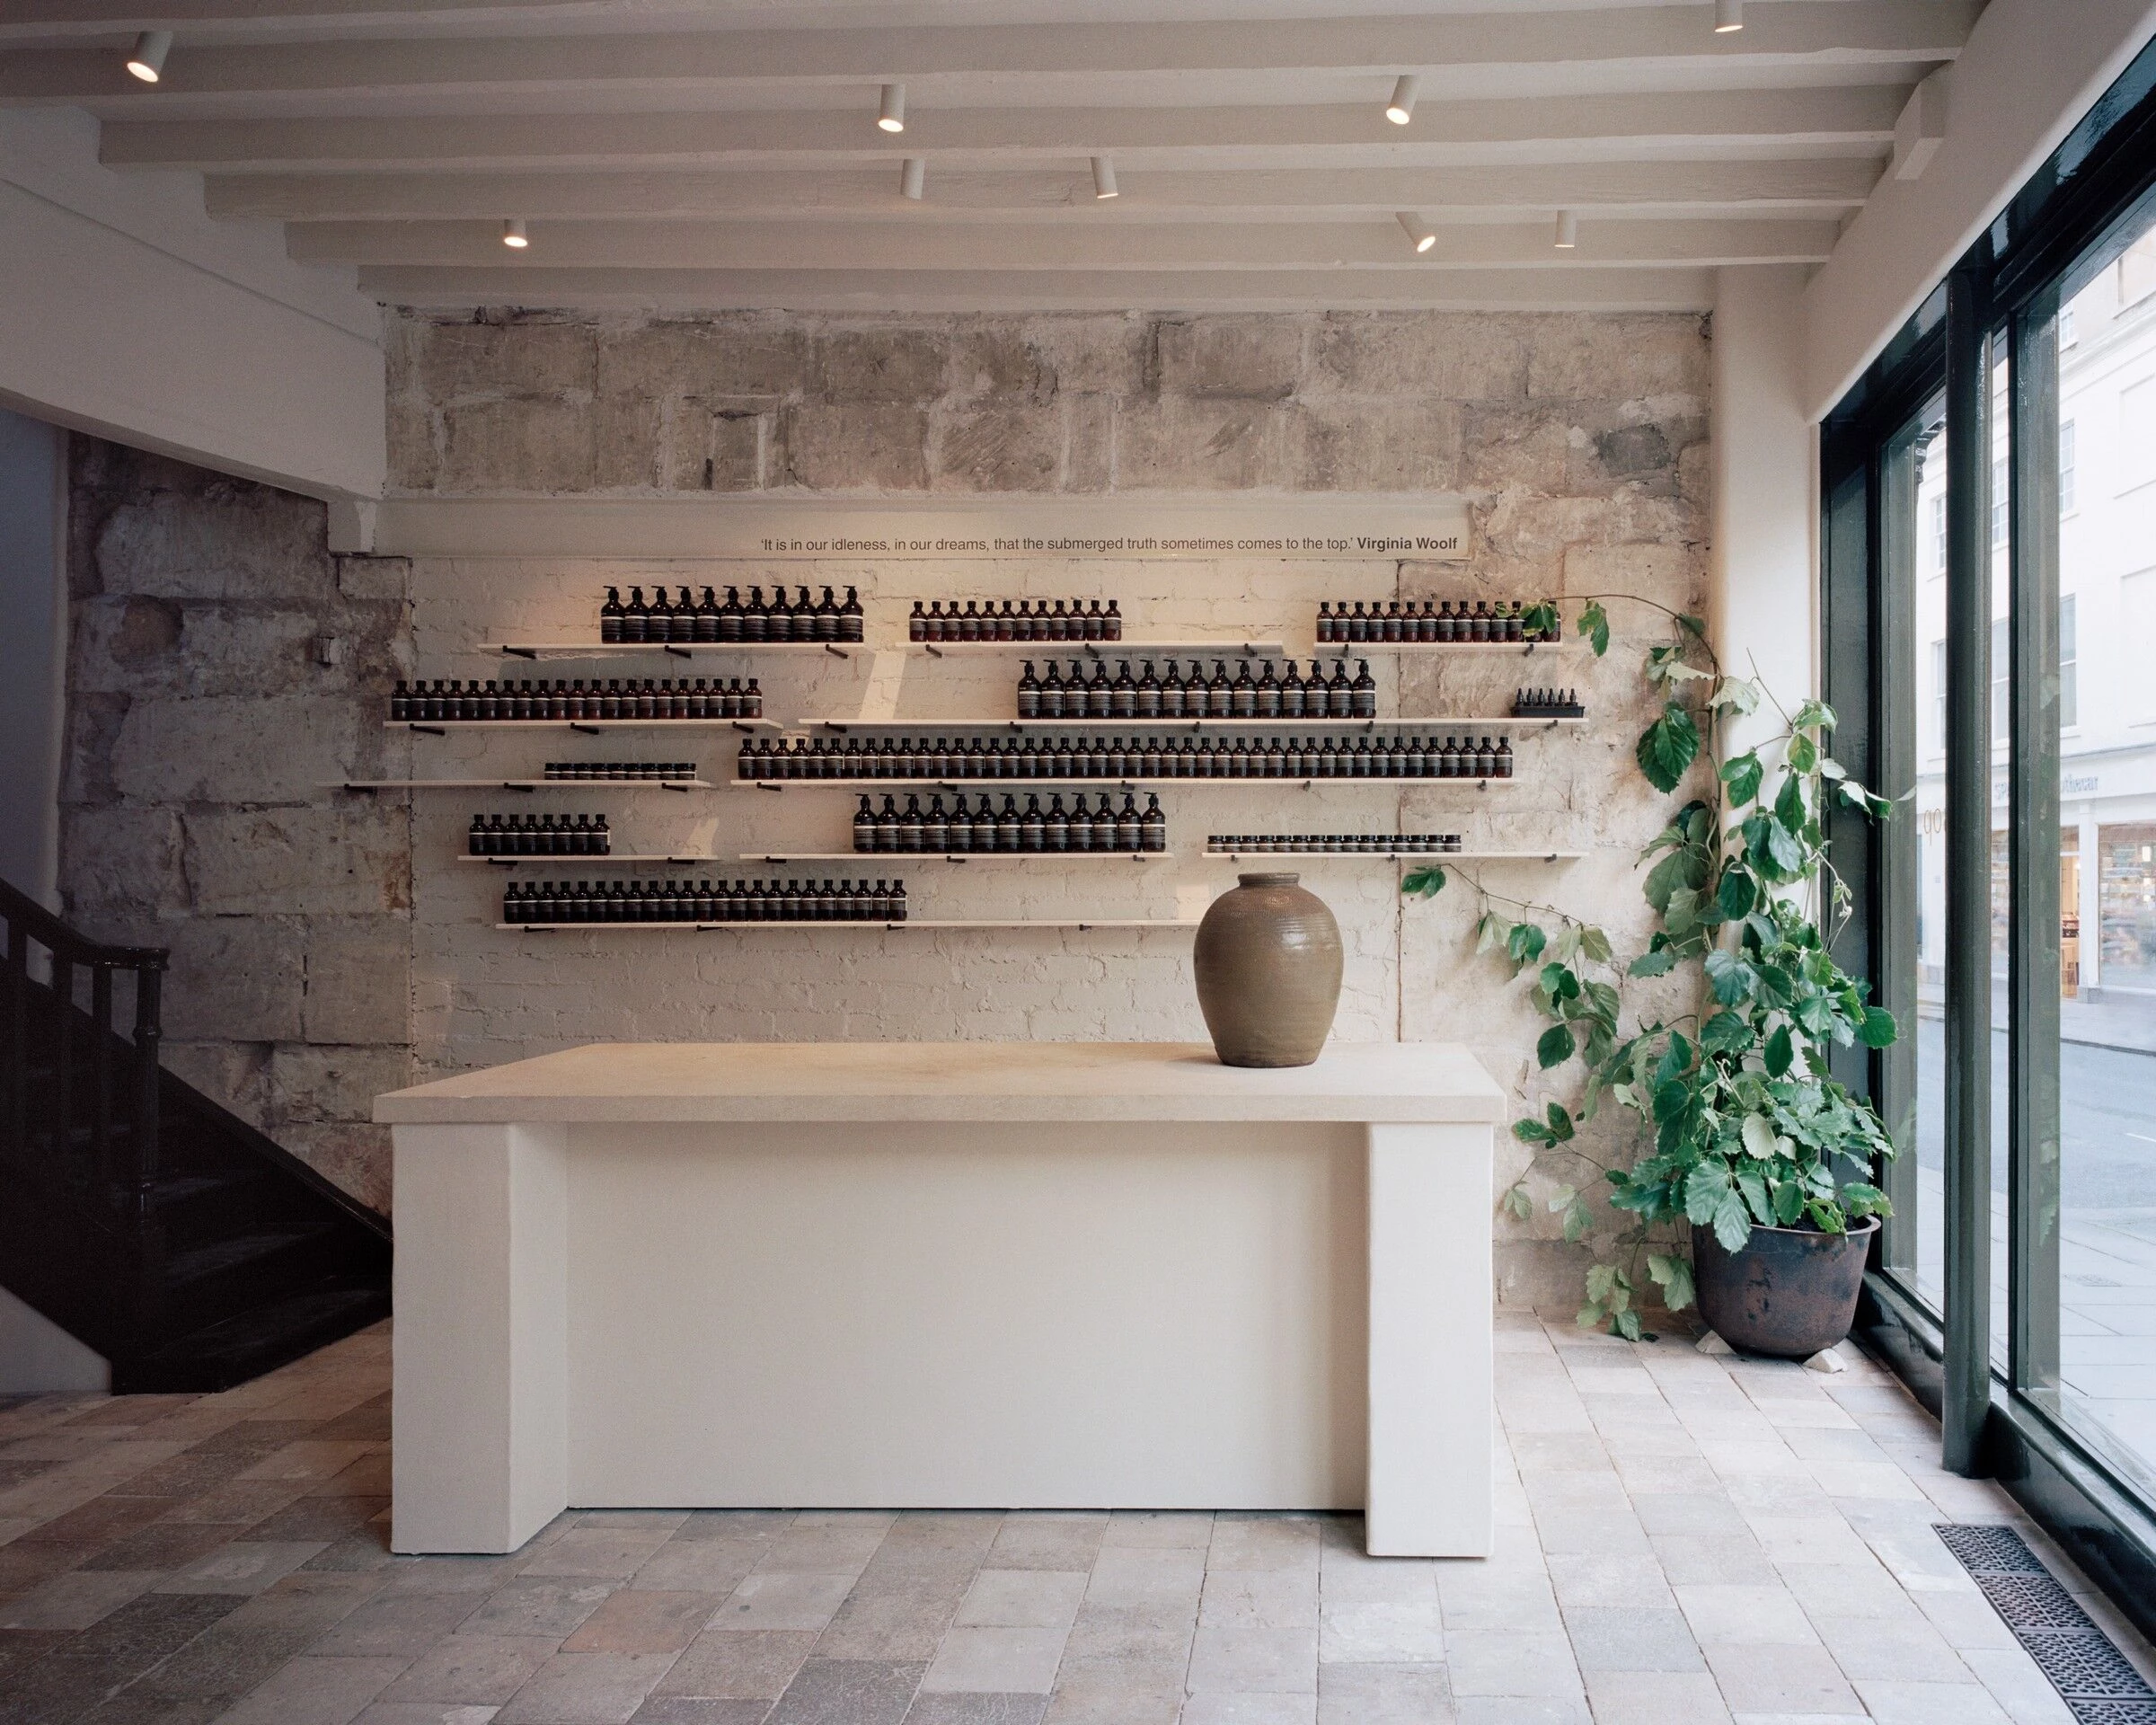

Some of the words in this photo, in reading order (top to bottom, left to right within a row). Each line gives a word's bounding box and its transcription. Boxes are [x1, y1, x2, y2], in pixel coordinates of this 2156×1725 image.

[776, 539, 787, 551] is
[791, 539, 802, 551] in
[806, 541, 828, 551] our
[832, 538, 891, 553] idleness,
[894, 538, 906, 550] in
[909, 540, 932, 550] our
[935, 538, 990, 553] dreams,
[994, 537, 1020, 550] that
[1022, 537, 1044, 550] the
[1047, 537, 1123, 553] submerged
[1127, 537, 1157, 549] truth
[1161, 537, 1234, 550] sometimes
[1237, 540, 1283, 550] comes
[1286, 538, 1299, 550] to
[1302, 537, 1323, 549] the
[1357, 537, 1412, 553] Virginia
[1416, 537, 1458, 550] Woolf
